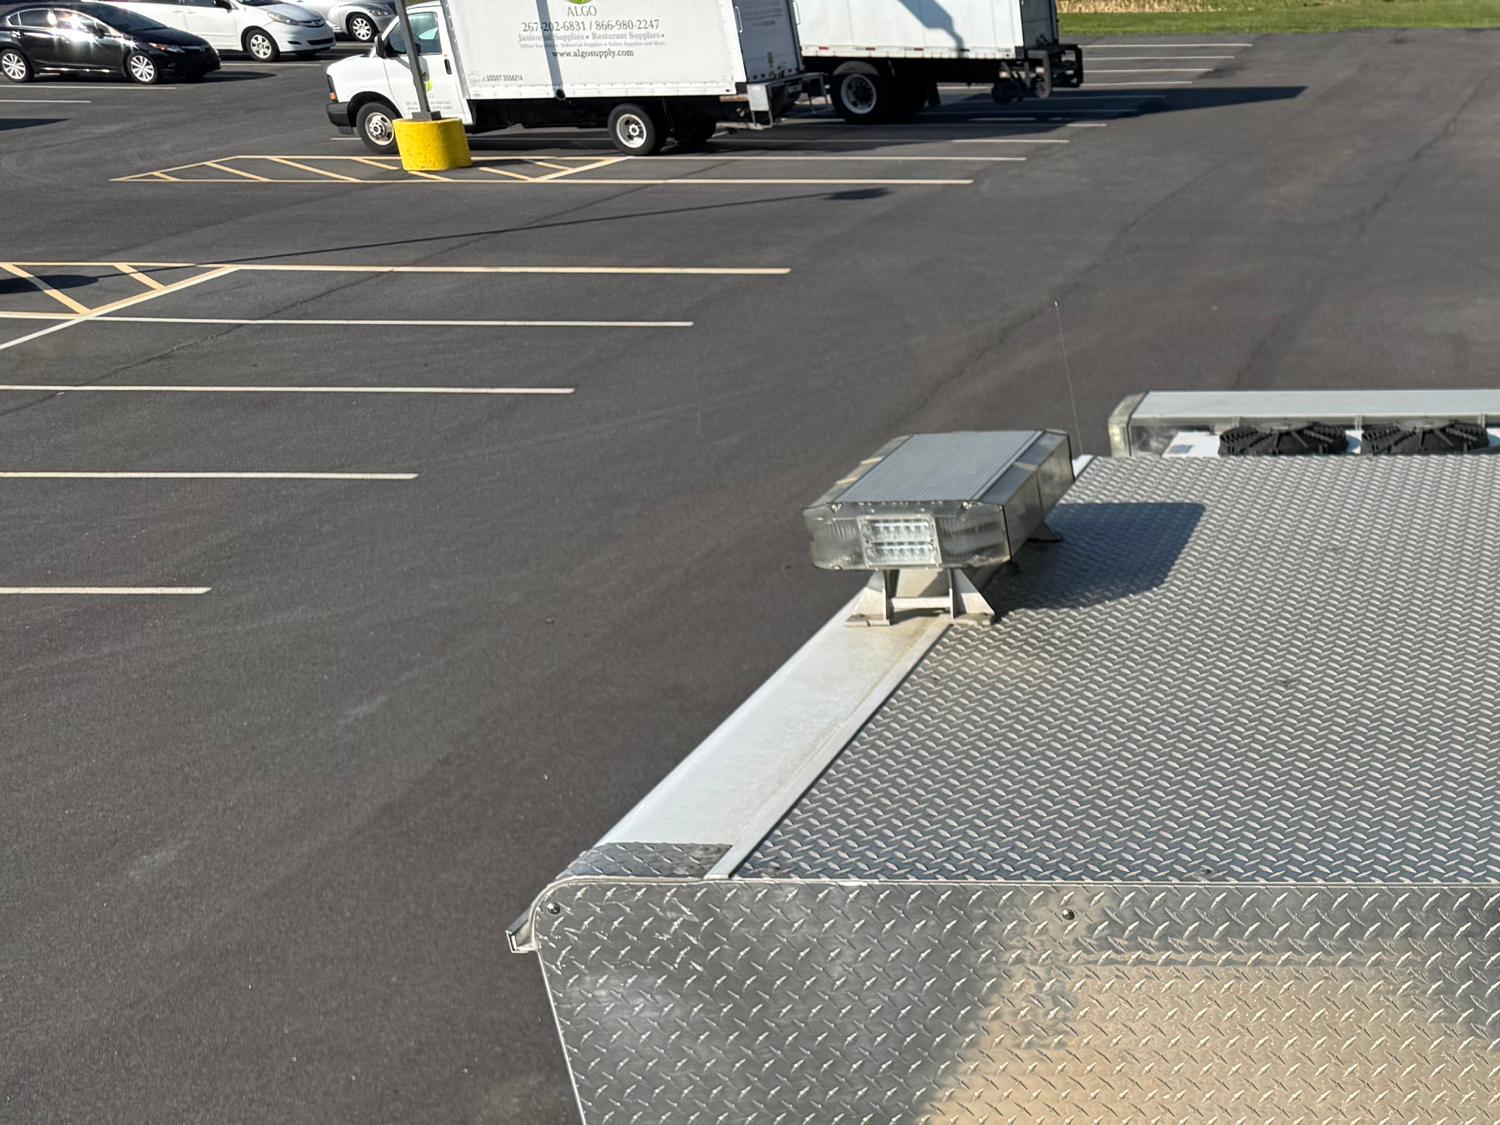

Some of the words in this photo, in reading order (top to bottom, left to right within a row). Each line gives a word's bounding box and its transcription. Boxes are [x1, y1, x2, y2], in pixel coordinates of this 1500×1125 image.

[567, 5, 597, 17] ALGO
[521, 20, 586, 32] 267-202-6831
[594, 19, 660, 31] 866-980-2247
[552, 48, 634, 59] www.algosupply.com
